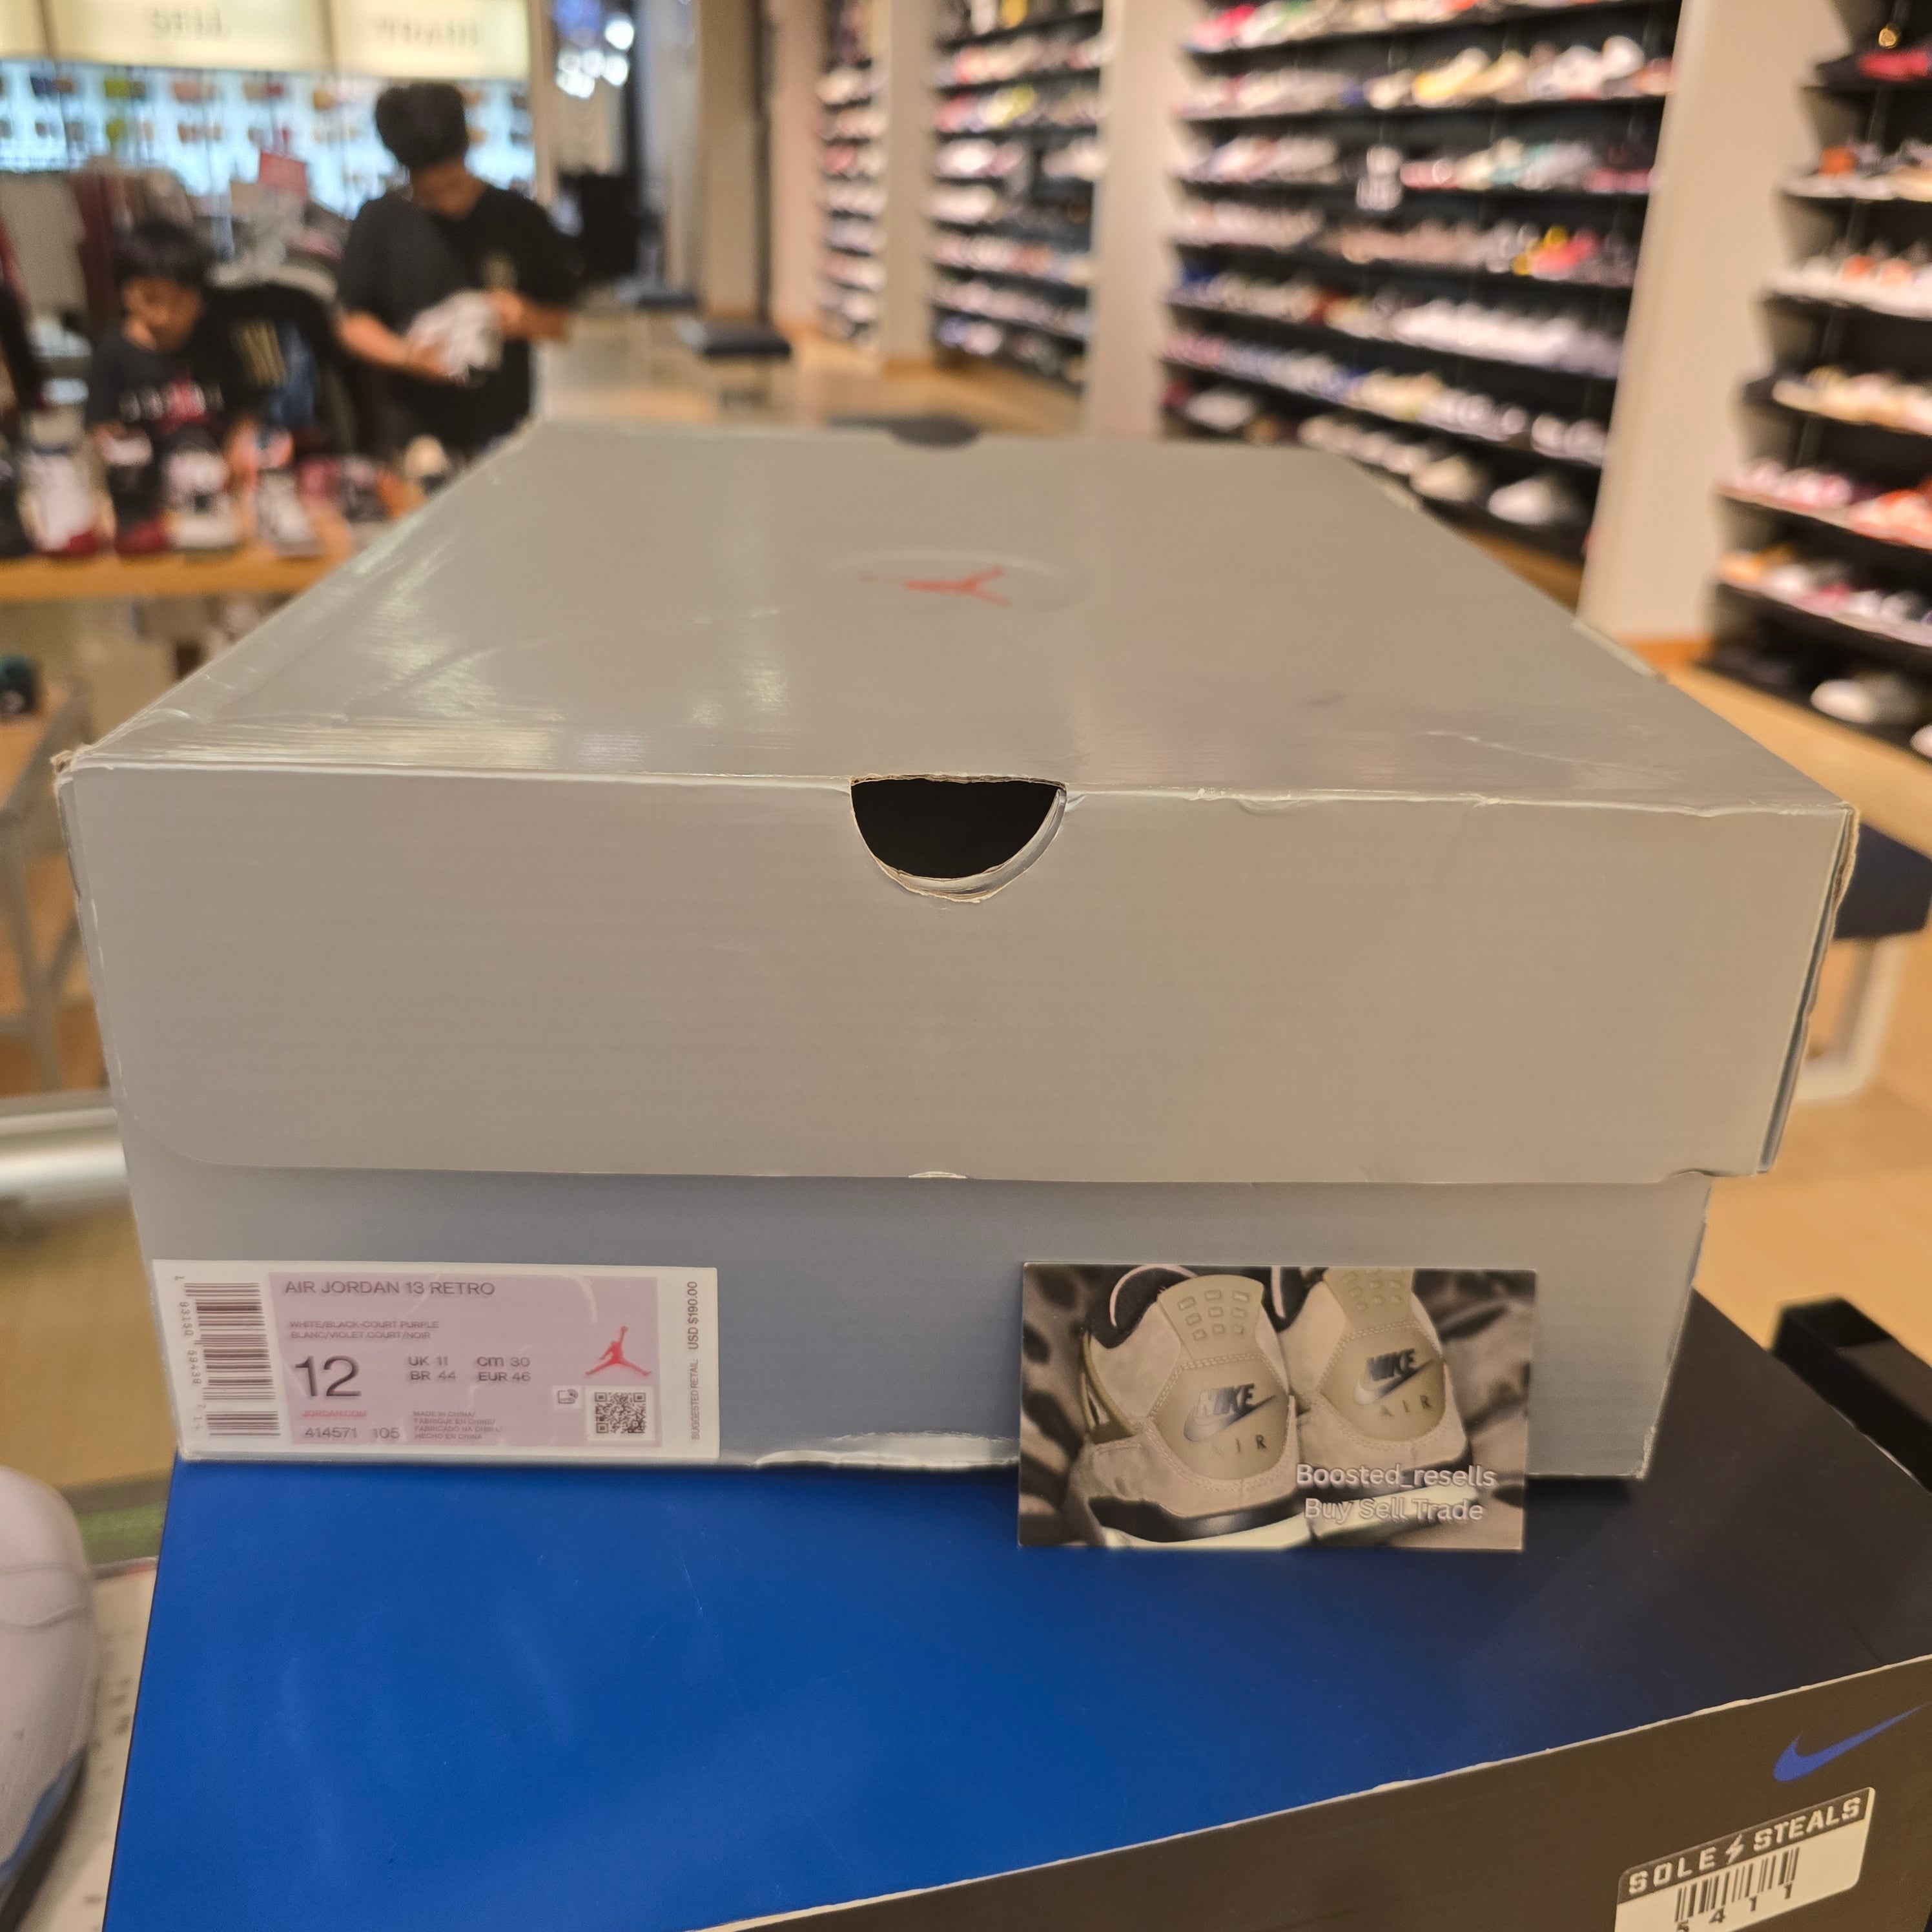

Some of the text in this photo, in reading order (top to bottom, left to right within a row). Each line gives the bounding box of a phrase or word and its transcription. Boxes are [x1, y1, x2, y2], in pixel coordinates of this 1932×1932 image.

[285, 1280, 495, 1295] AIR JORDAN 13 RETRO
[687, 1281, 699, 1324] $190.00
[688, 1326, 699, 1350] USD
[408, 1356, 449, 1366] UK 11
[511, 1357, 530, 1367] 30
[1364, 1348, 1415, 1382] NIKE
[295, 1355, 362, 1397] 12
[410, 1370, 456, 1381] BR 44
[478, 1372, 531, 1382] EUR 46
[1195, 1382, 1255, 1418] NIKE
[305, 1427, 357, 1438] 414571
[1296, 1463, 1495, 1488] Boosted_resells
[1305, 1497, 1484, 1525] Buy Sell Trade
[1629, 1796, 1861, 1895] SOLE STEALS
